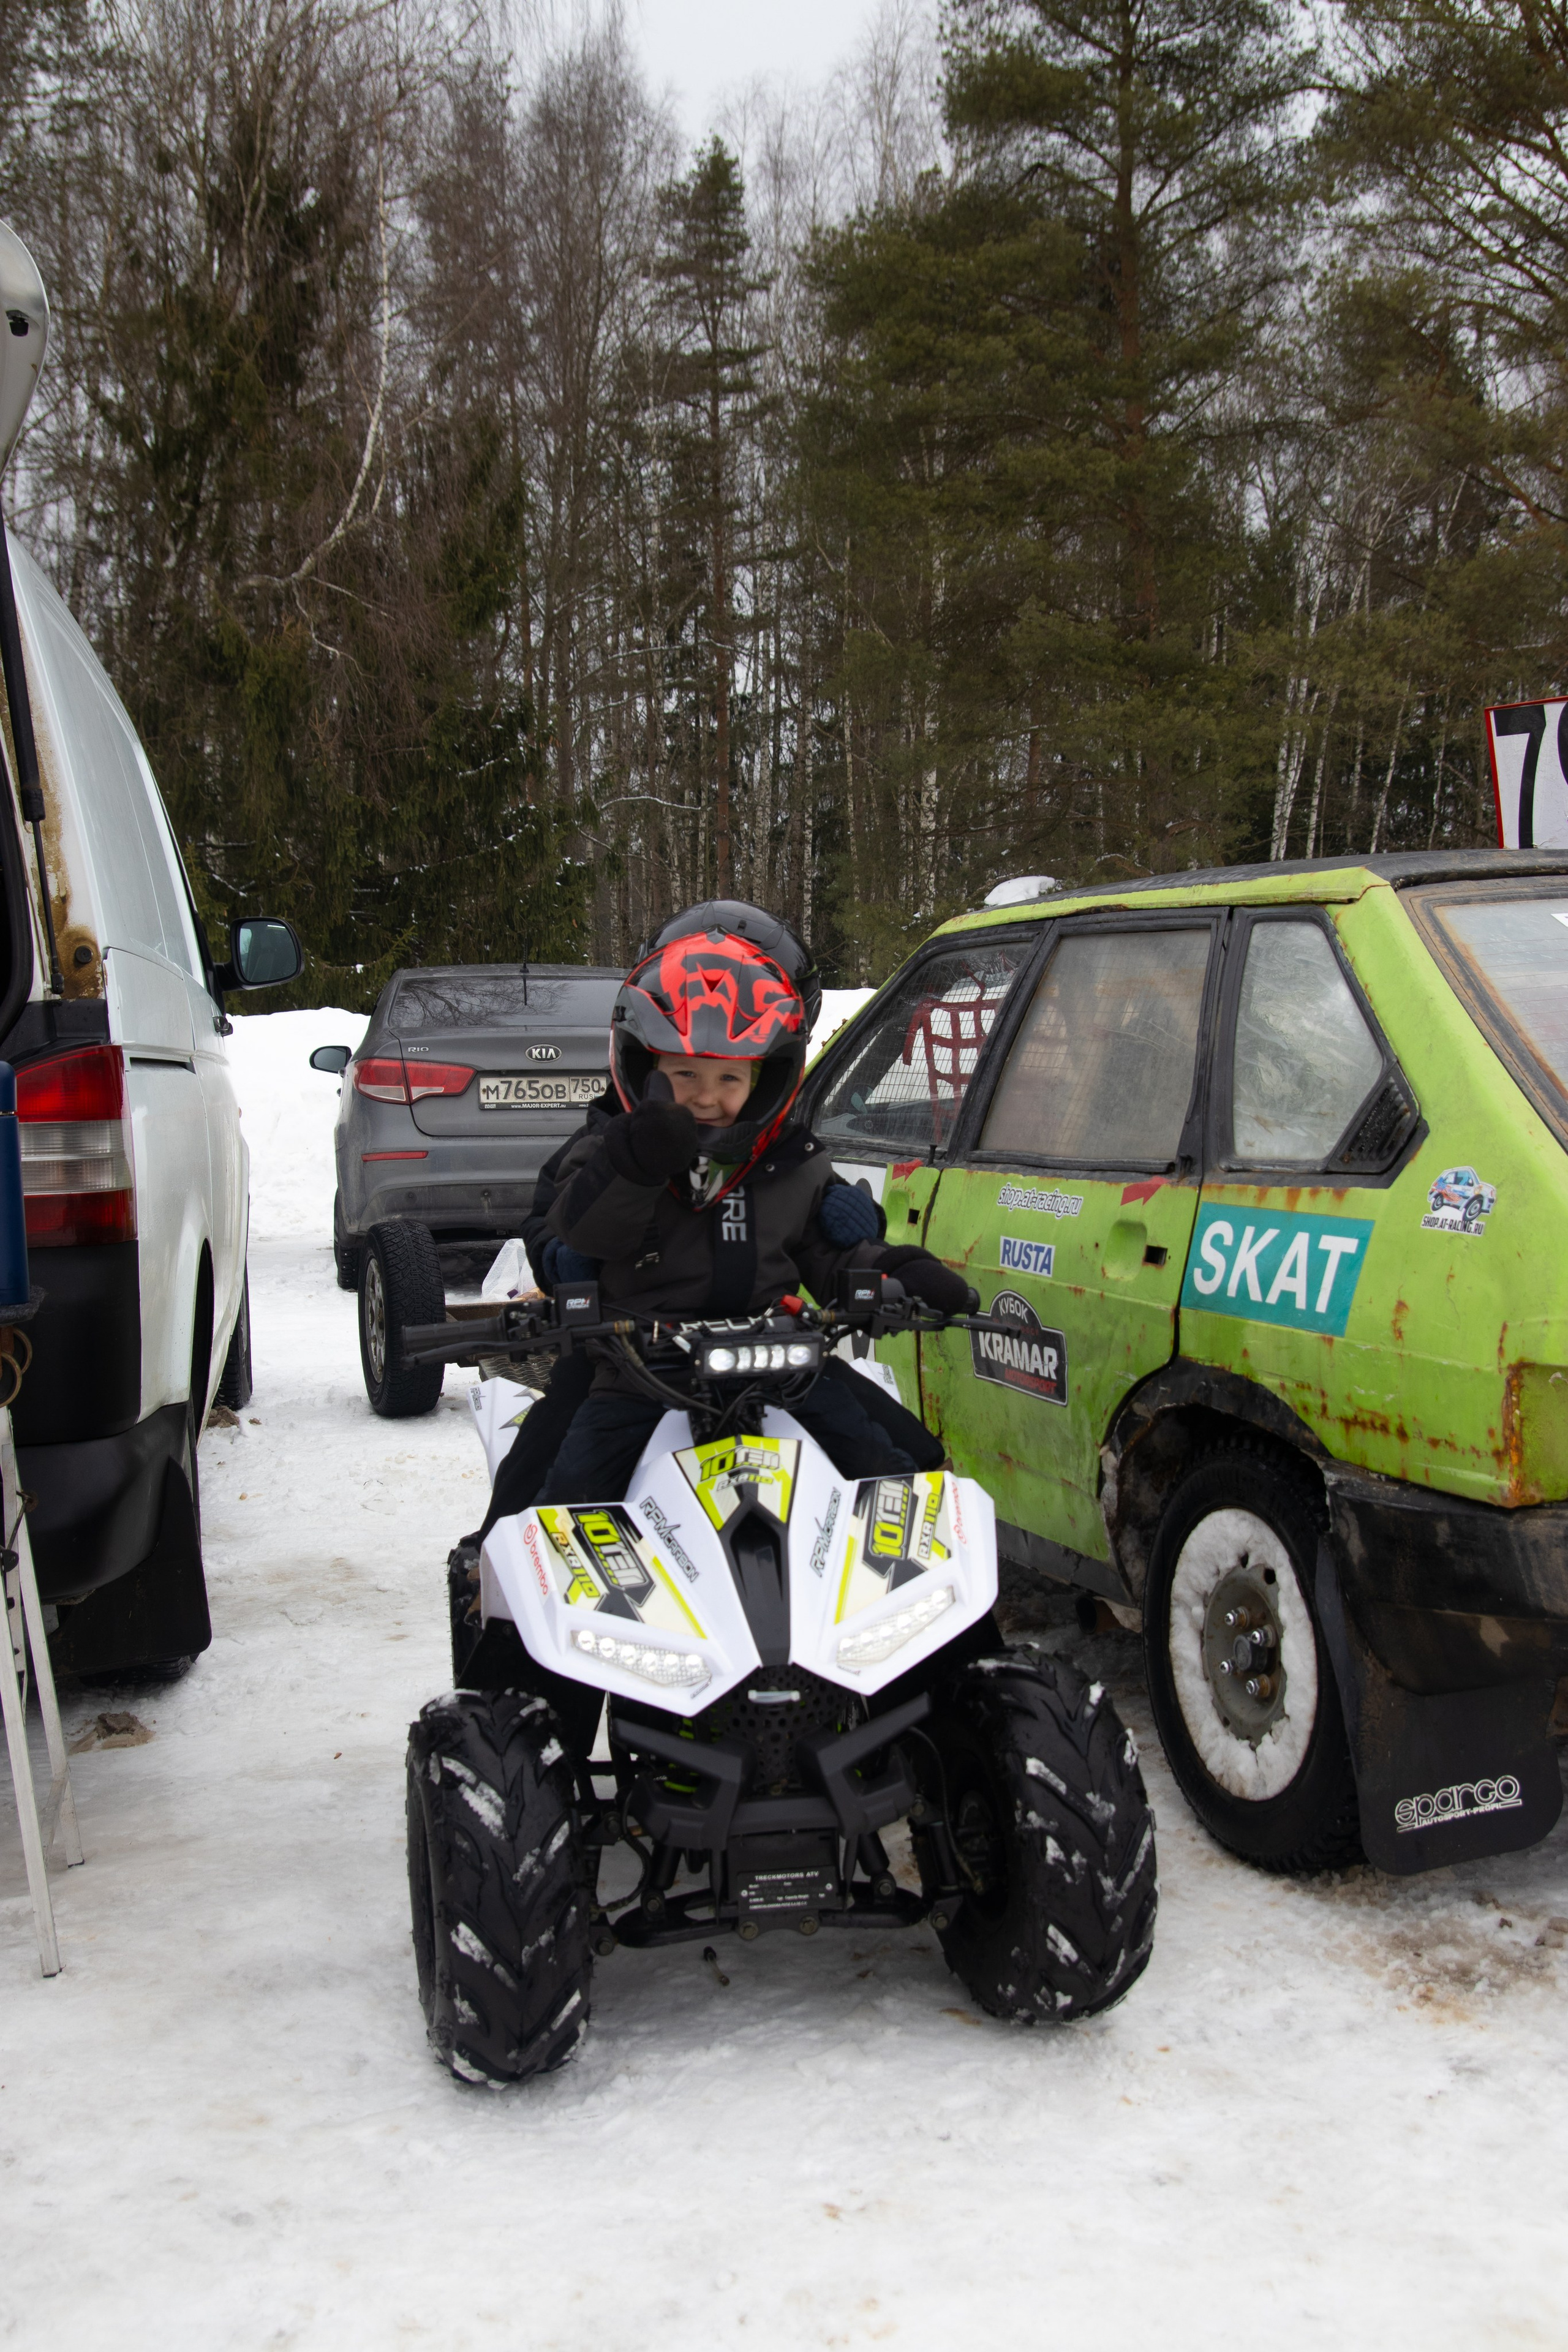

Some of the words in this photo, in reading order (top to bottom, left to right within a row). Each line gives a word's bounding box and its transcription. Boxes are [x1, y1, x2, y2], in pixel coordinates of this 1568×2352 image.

[1493, 704, 1568, 849] 7
[532, 1048, 557, 1059] KIA
[571, 1078, 601, 1094] 750
[998, 1183, 1082, 1218] shop.at-racing.ru
[1421, 1215, 1483, 1235] SHOP.AT-RACING.RU
[1001, 1238, 1053, 1275] RUSTA
[1193, 1220, 1359, 1314] SKAT
[999, 1297, 1029, 1324] КУБОК
[979, 1331, 1058, 1380] KRAMAR
[530, 1540, 548, 1595] brembo
[1395, 1775, 1520, 1828] sparco
[755, 1872, 804, 1881] TRECKMOTORS
